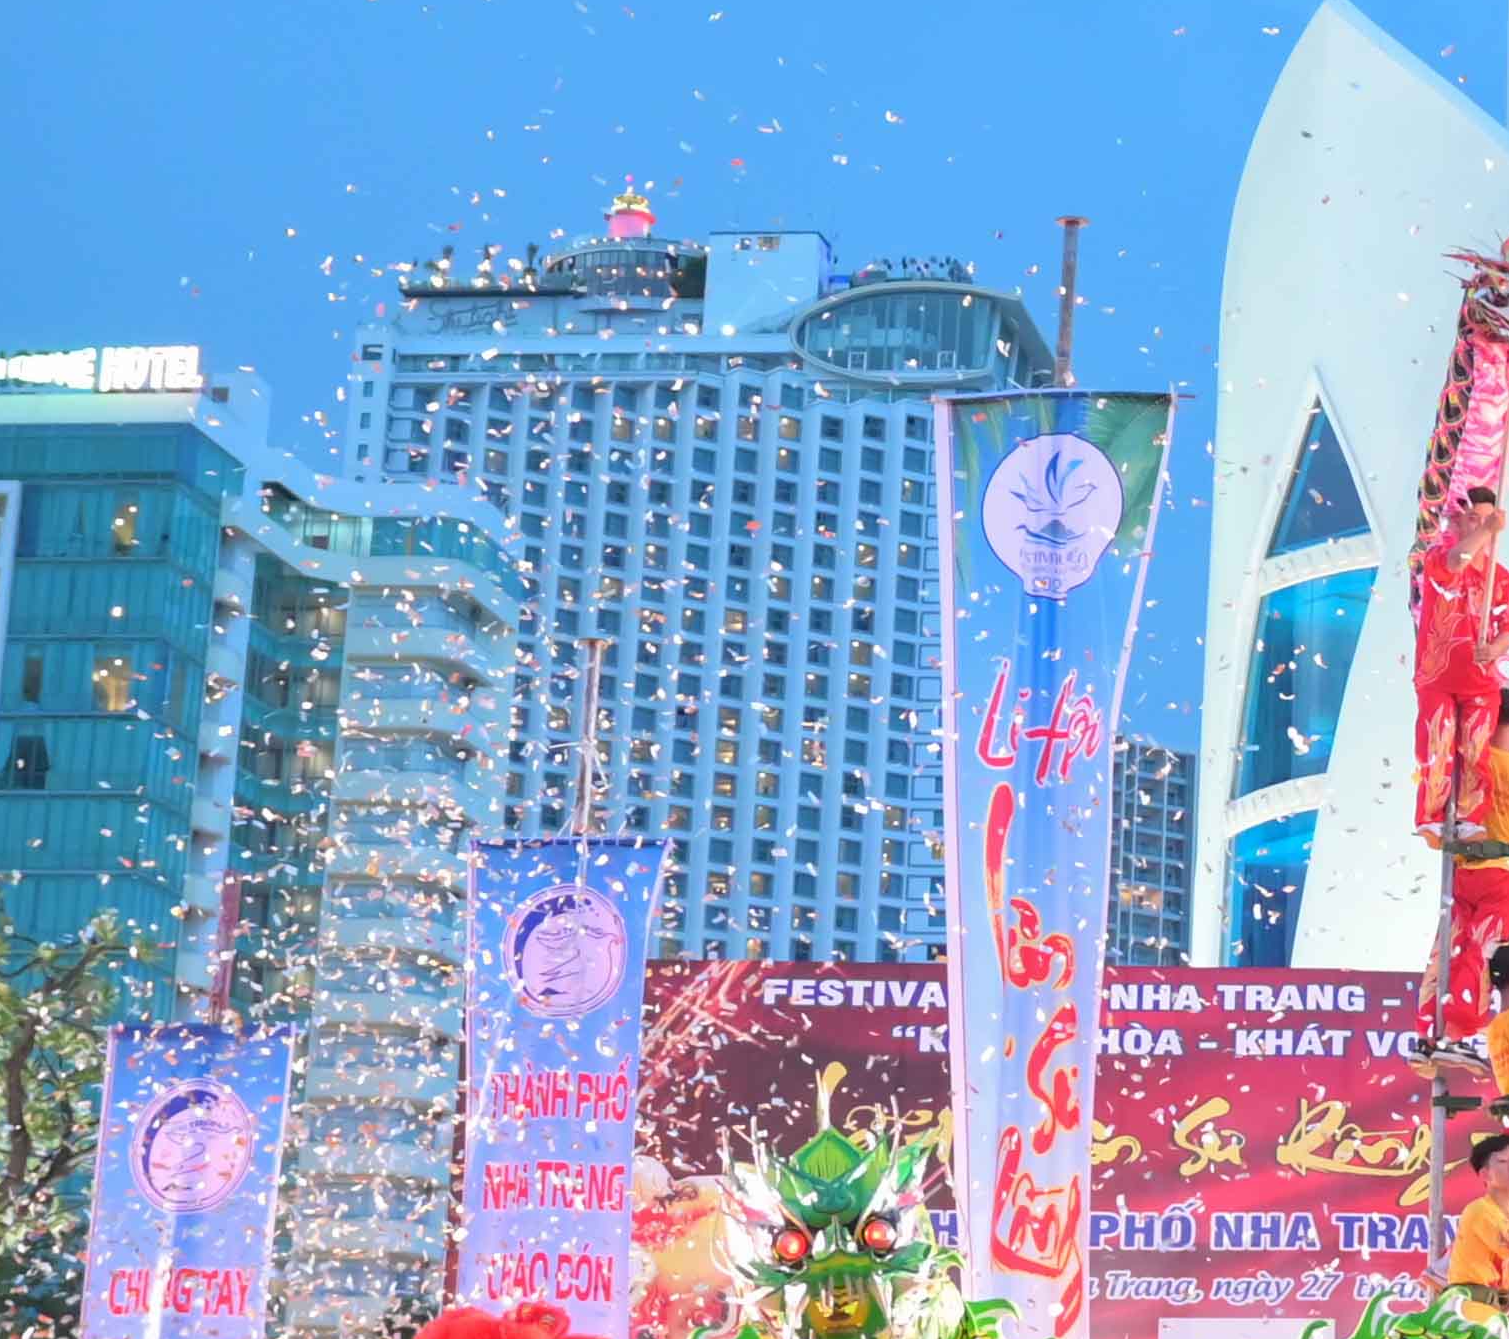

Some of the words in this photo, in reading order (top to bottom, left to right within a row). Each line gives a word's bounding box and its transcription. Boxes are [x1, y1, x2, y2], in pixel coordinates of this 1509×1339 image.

[762, 978, 949, 1009] FESTIVA
[1109, 983, 1199, 1012] NHA
[1217, 983, 1366, 1013] TRANG
[1235, 1023, 1351, 1058] KHÁT
[491, 1059, 569, 1121] THÀNH
[575, 1054, 631, 1122] PHỐ
[1173, 1096, 1245, 1178] Sư
[483, 1163, 529, 1211] NHA
[536, 1161, 626, 1211] TRANG
[1089, 1200, 1199, 1251] PHỐ
[1210, 1211, 1321, 1252] NHA
[202, 1270, 255, 1316] TAY
[486, 1240, 549, 1302] CHÀO
[1104, 1269, 1204, 1304] Trang,
[1209, 1271, 1293, 1306] ngày
[1297, 1272, 1344, 1302] 27
